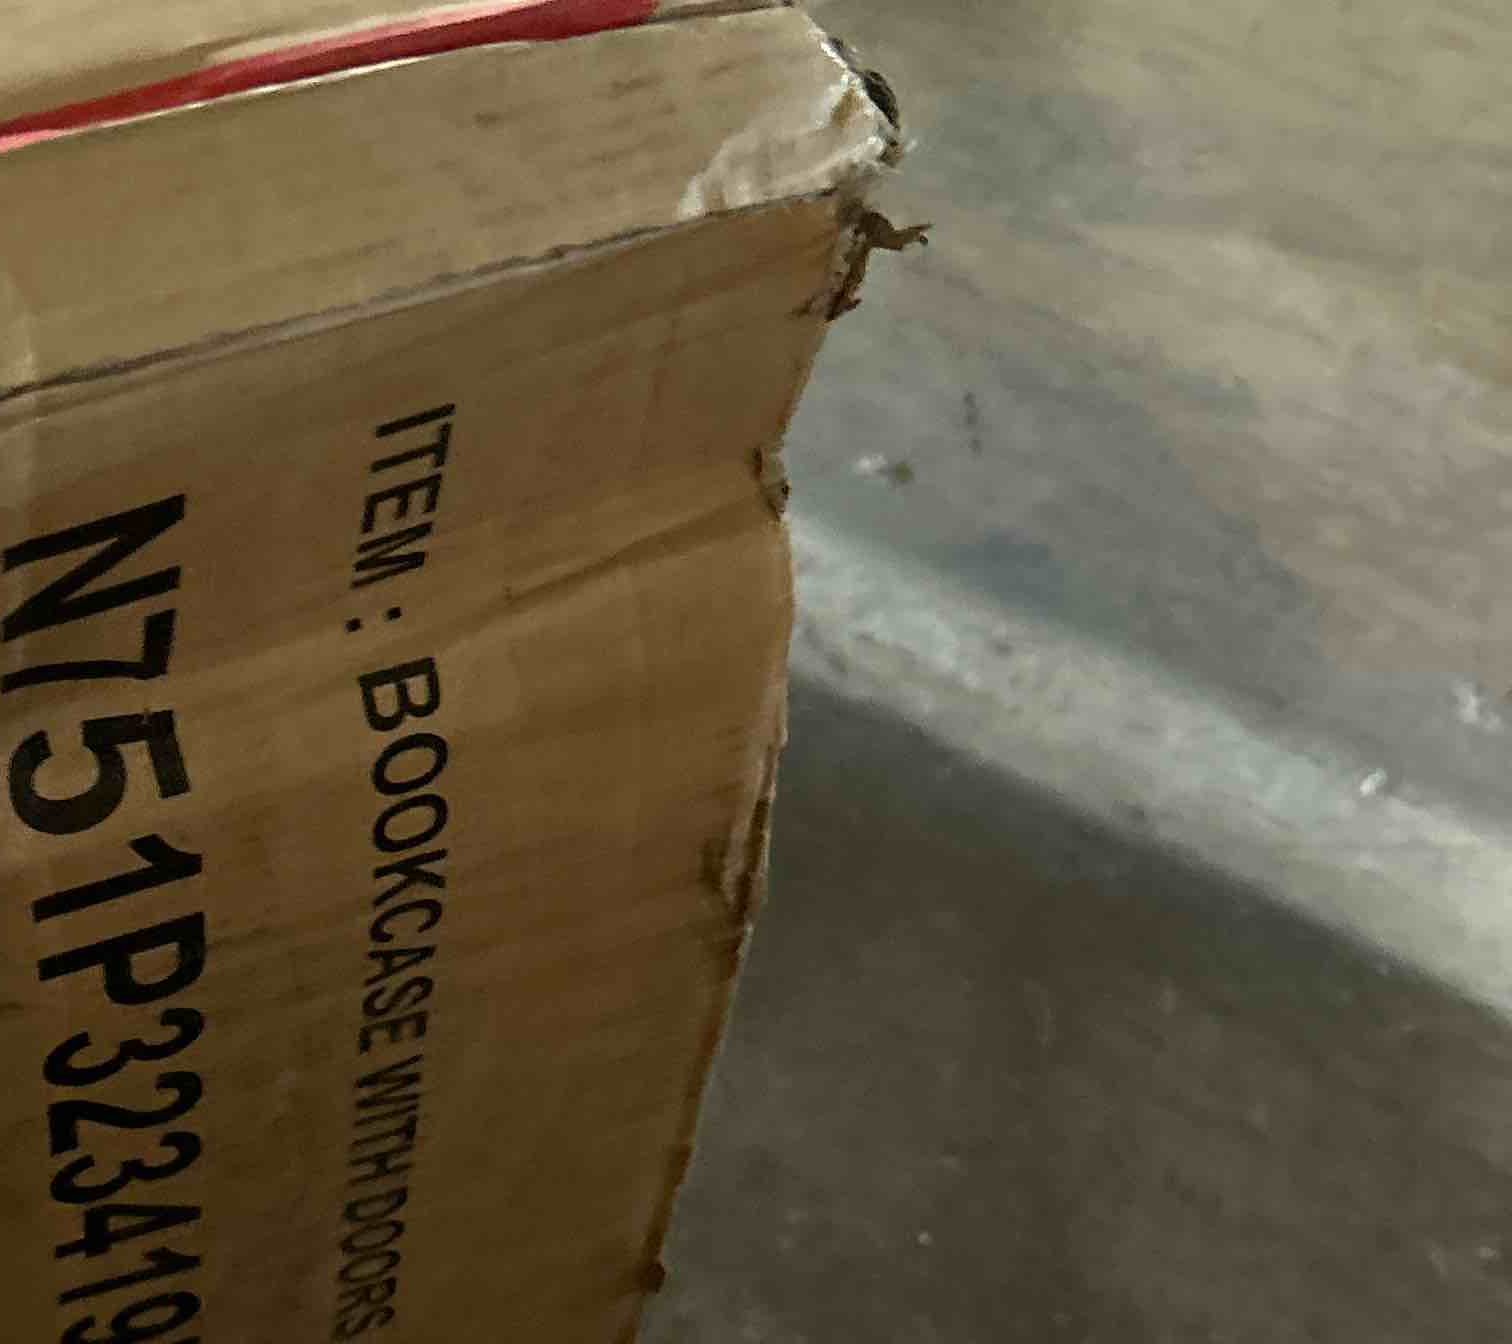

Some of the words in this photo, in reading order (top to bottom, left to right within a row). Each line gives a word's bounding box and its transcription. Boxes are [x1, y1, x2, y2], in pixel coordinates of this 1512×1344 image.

[357, 656, 450, 1056] BOOKCASE
[345, 1054, 425, 1188] WITH
[331, 1185, 410, 1344] DOORS
